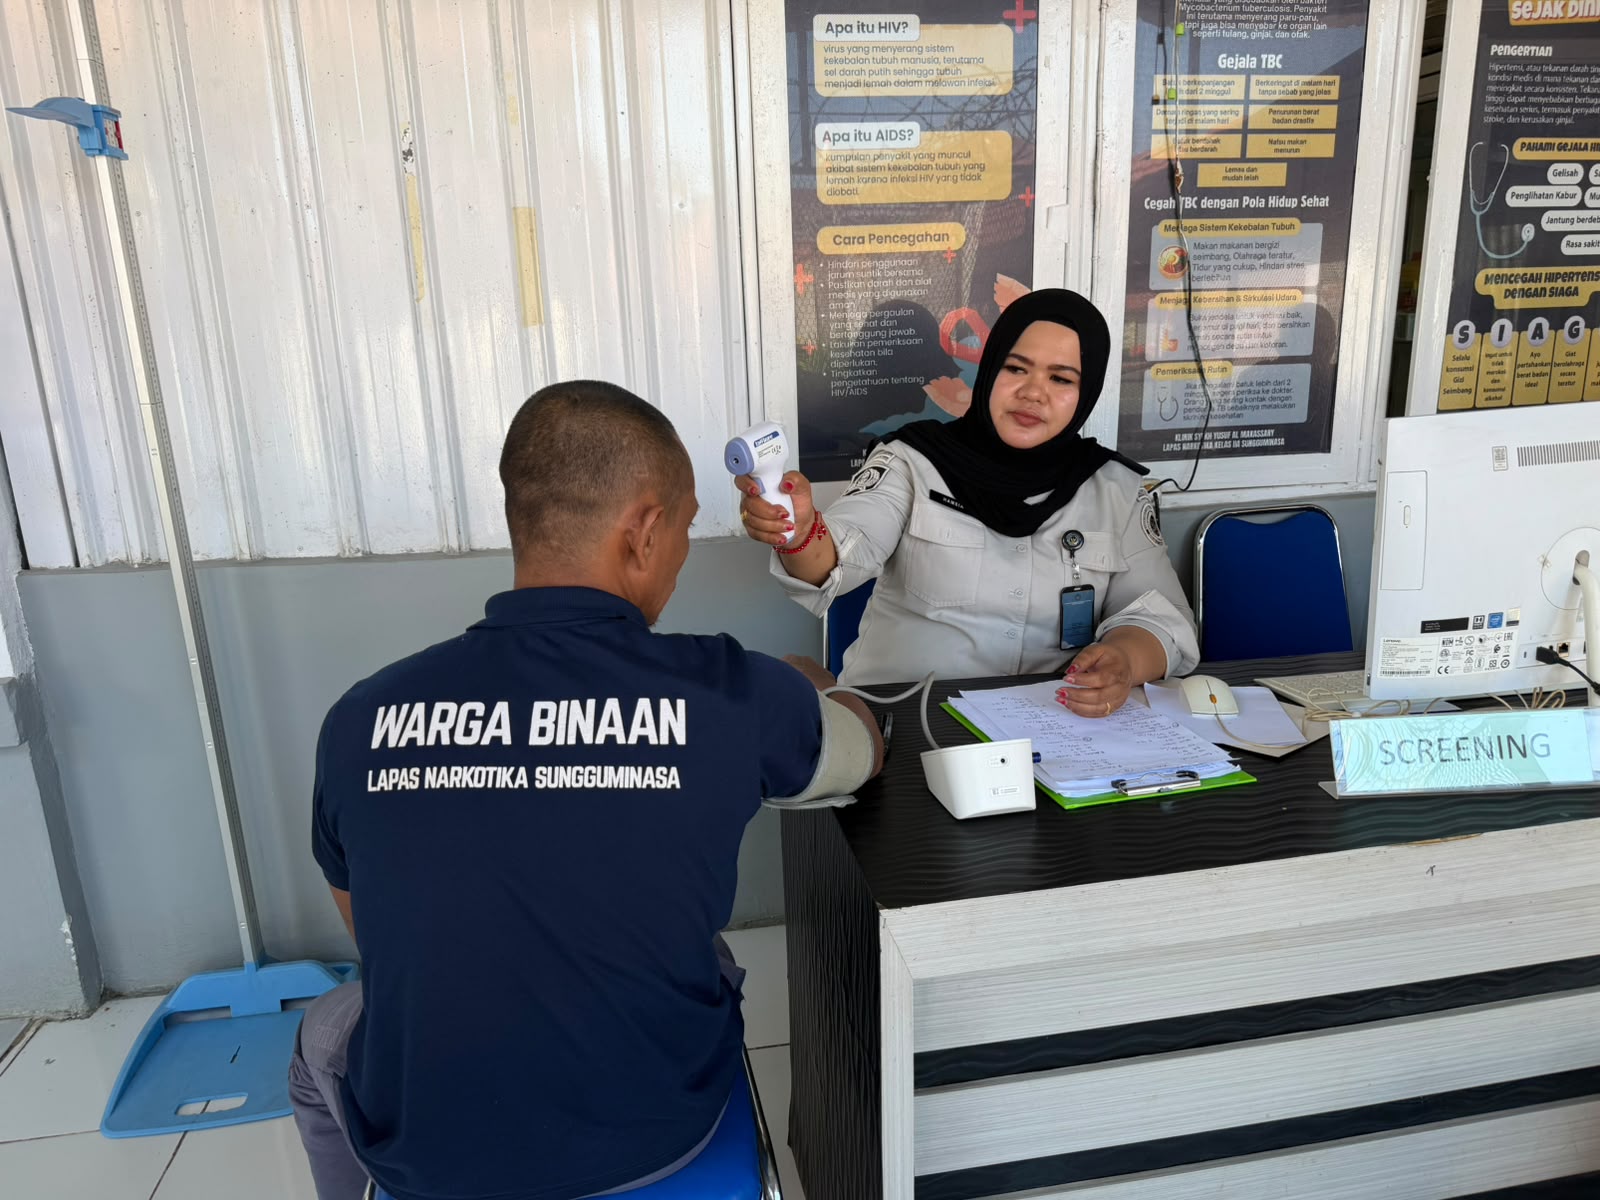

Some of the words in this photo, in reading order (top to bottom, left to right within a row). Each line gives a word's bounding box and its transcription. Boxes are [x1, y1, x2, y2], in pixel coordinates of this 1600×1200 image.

[1179, 3, 1240, 13] Mycobacterium
[1294, 5, 1327, 14] Penyakit
[825, 22, 853, 36] Apa
[857, 22, 873, 33] itu
[878, 21, 908, 33] HIV?
[1201, 22, 1218, 30] juga
[1238, 22, 1276, 30] menyebar
[1290, 23, 1311, 31] organ
[824, 45, 844, 53] virus
[847, 46, 869, 55] yang
[872, 45, 923, 55] menyerang
[925, 44, 954, 53] sistem
[824, 56, 870, 64] kekebalan
[872, 56, 898, 64] tubuh
[901, 56, 941, 65] manusia,
[1218, 54, 1257, 69] Gejala
[1261, 54, 1282, 69] TBC
[869, 68, 891, 78] putih
[893, 67, 934, 78] sehingga
[936, 67, 961, 76] tubuh
[825, 80, 861, 90] menjadi
[823, 131, 849, 146] Apa
[854, 130, 871, 141] itu
[876, 129, 914, 141] AIDS?
[873, 152, 910, 162] penyakit
[913, 152, 935, 162] yang
[826, 164, 853, 173] akibat
[888, 163, 933, 171] kekebalan
[963, 162, 985, 172] yang
[920, 175, 933, 183] HIV
[936, 174, 958, 185] yang
[1511, 192, 1554, 201] Penglihatan
[1556, 191, 1576, 199] Kabur
[1144, 197, 1175, 210] Cegah
[1201, 196, 1239, 209] dengan
[1243, 196, 1265, 208] Pola
[1268, 196, 1297, 209] Hidup
[1301, 196, 1329, 208] Sehat
[1546, 216, 1574, 225] Jantung
[833, 235, 865, 246] Cara
[869, 231, 949, 248] Pencegahan
[1255, 242, 1279, 251] bergizi
[1233, 252, 1266, 261] Olahraga
[828, 260, 859, 268] Hindari
[861, 258, 918, 269] penggunaan
[828, 270, 853, 280] jarum
[855, 269, 882, 278] suntik
[884, 268, 923, 276] bersama
[829, 281, 865, 289] Pastikan
[867, 279, 893, 287] darah
[857, 291, 880, 300] yang
[882, 288, 928, 298] digunakan
[1549, 287, 1578, 297] SIAGA
[830, 311, 867, 321] Menjaga
[870, 308, 914, 318] pergaulan
[830, 321, 851, 330] yang
[830, 328, 886, 339] bertanggung
[1458, 325, 1469, 344] S
[1498, 325, 1505, 341] I
[1531, 323, 1544, 340] A
[1568, 321, 1580, 339] G
[868, 337, 923, 348] pemeriksaan
[831, 350, 875, 359] kesehatan
[831, 359, 877, 369] diperlukan.
[832, 368, 877, 378] Tingkatkan
[831, 378, 889, 389] pengetahuan
[891, 376, 924, 386] tentang
[832, 387, 867, 397] HIV/AIDS
[1443, 387, 1472, 395] Seimbang
[1163, 443, 1181, 451] LAPAS
[371, 701, 512, 749] WARGA
[529, 698, 686, 745] BINAAN
[1379, 734, 1550, 766] SCREENING
[368, 768, 420, 791] LAPAS
[424, 766, 528, 789] NARKOTIKA
[535, 766, 681, 789] SUNGGUMINASA
